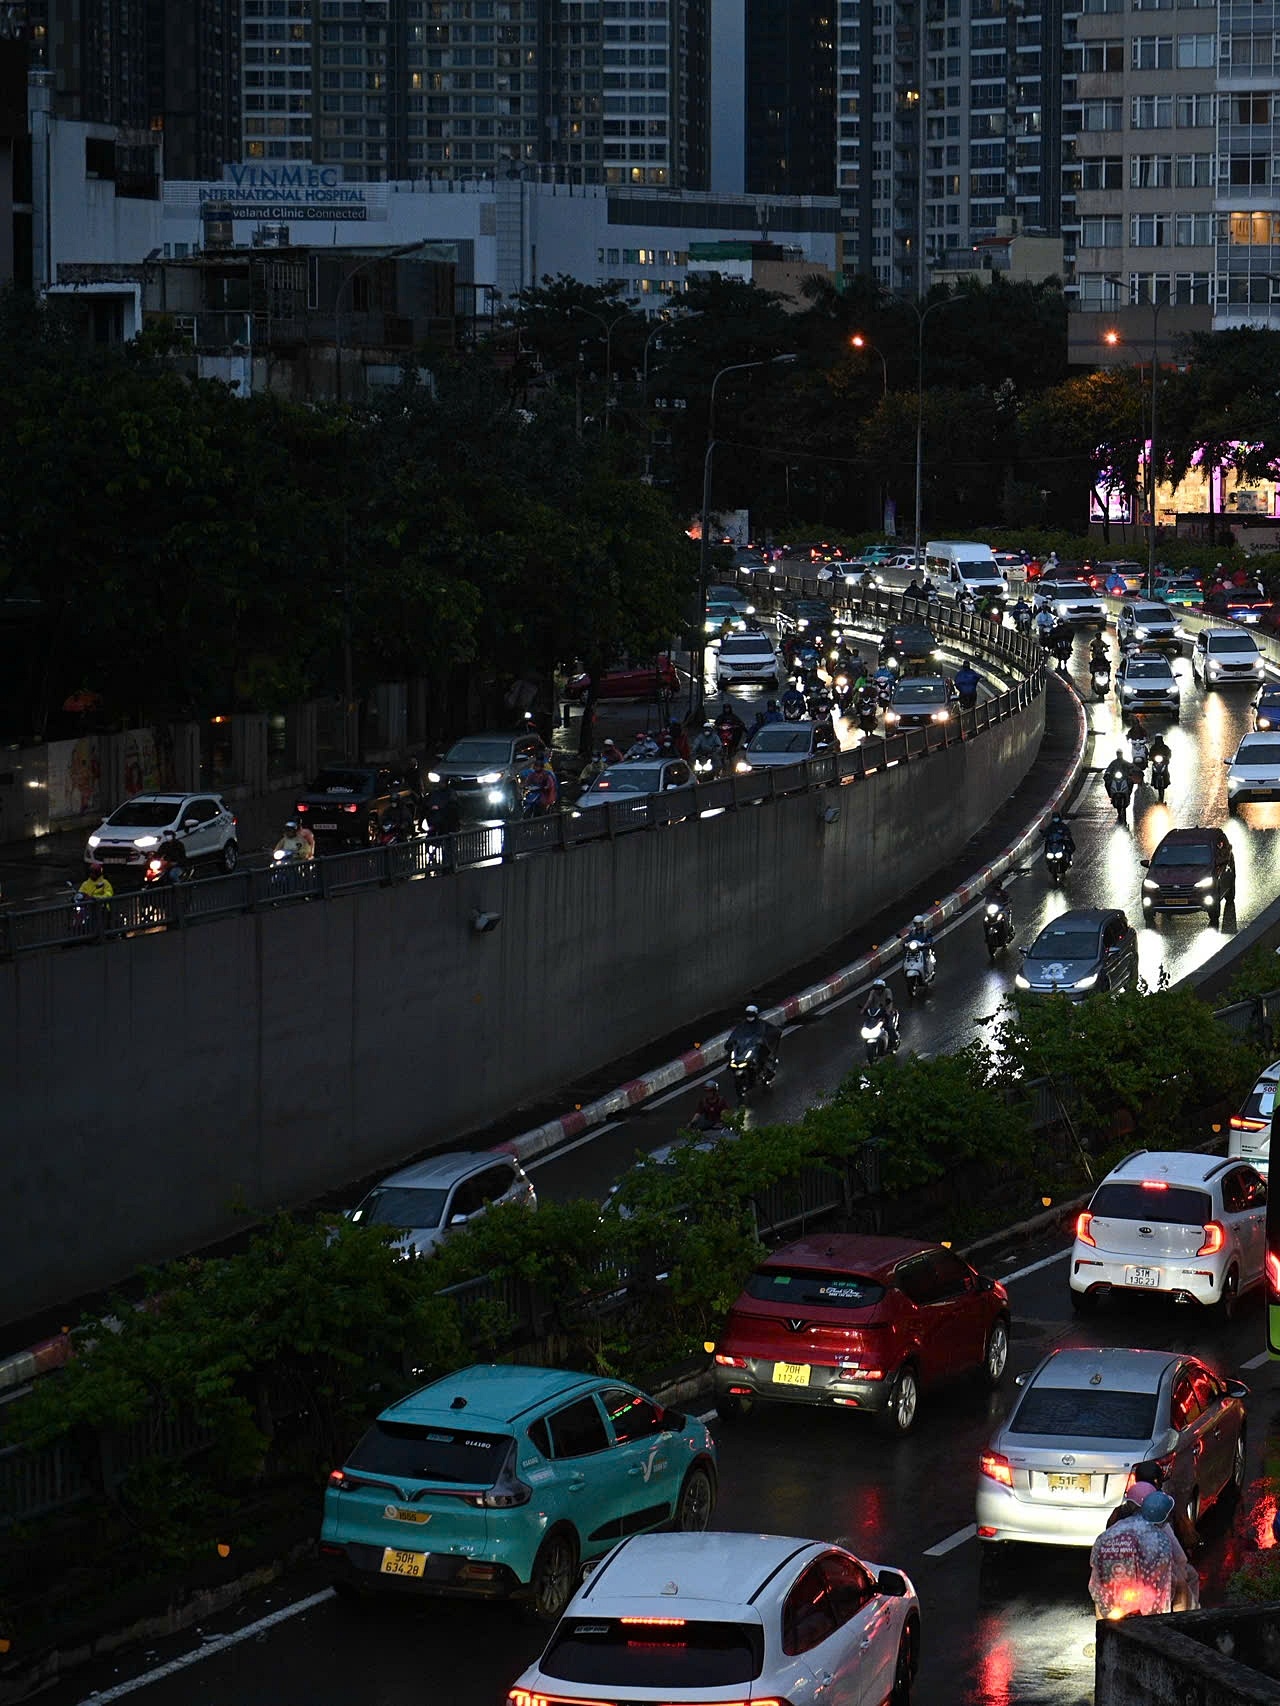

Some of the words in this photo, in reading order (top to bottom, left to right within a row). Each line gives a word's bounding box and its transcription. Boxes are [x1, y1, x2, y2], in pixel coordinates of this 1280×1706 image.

[228, 164, 337, 187] VINMEC
[200, 189, 300, 201] INTERNATIONAL
[305, 190, 366, 202] HOSPITAL
[233, 207, 270, 218] veland
[272, 207, 304, 218] Clinic
[306, 207, 366, 219] Connected
[1058, 1476, 1077, 1485] 51F
[395, 1552, 414, 1564] 50H
[385, 1561, 419, 1576] 634.28
